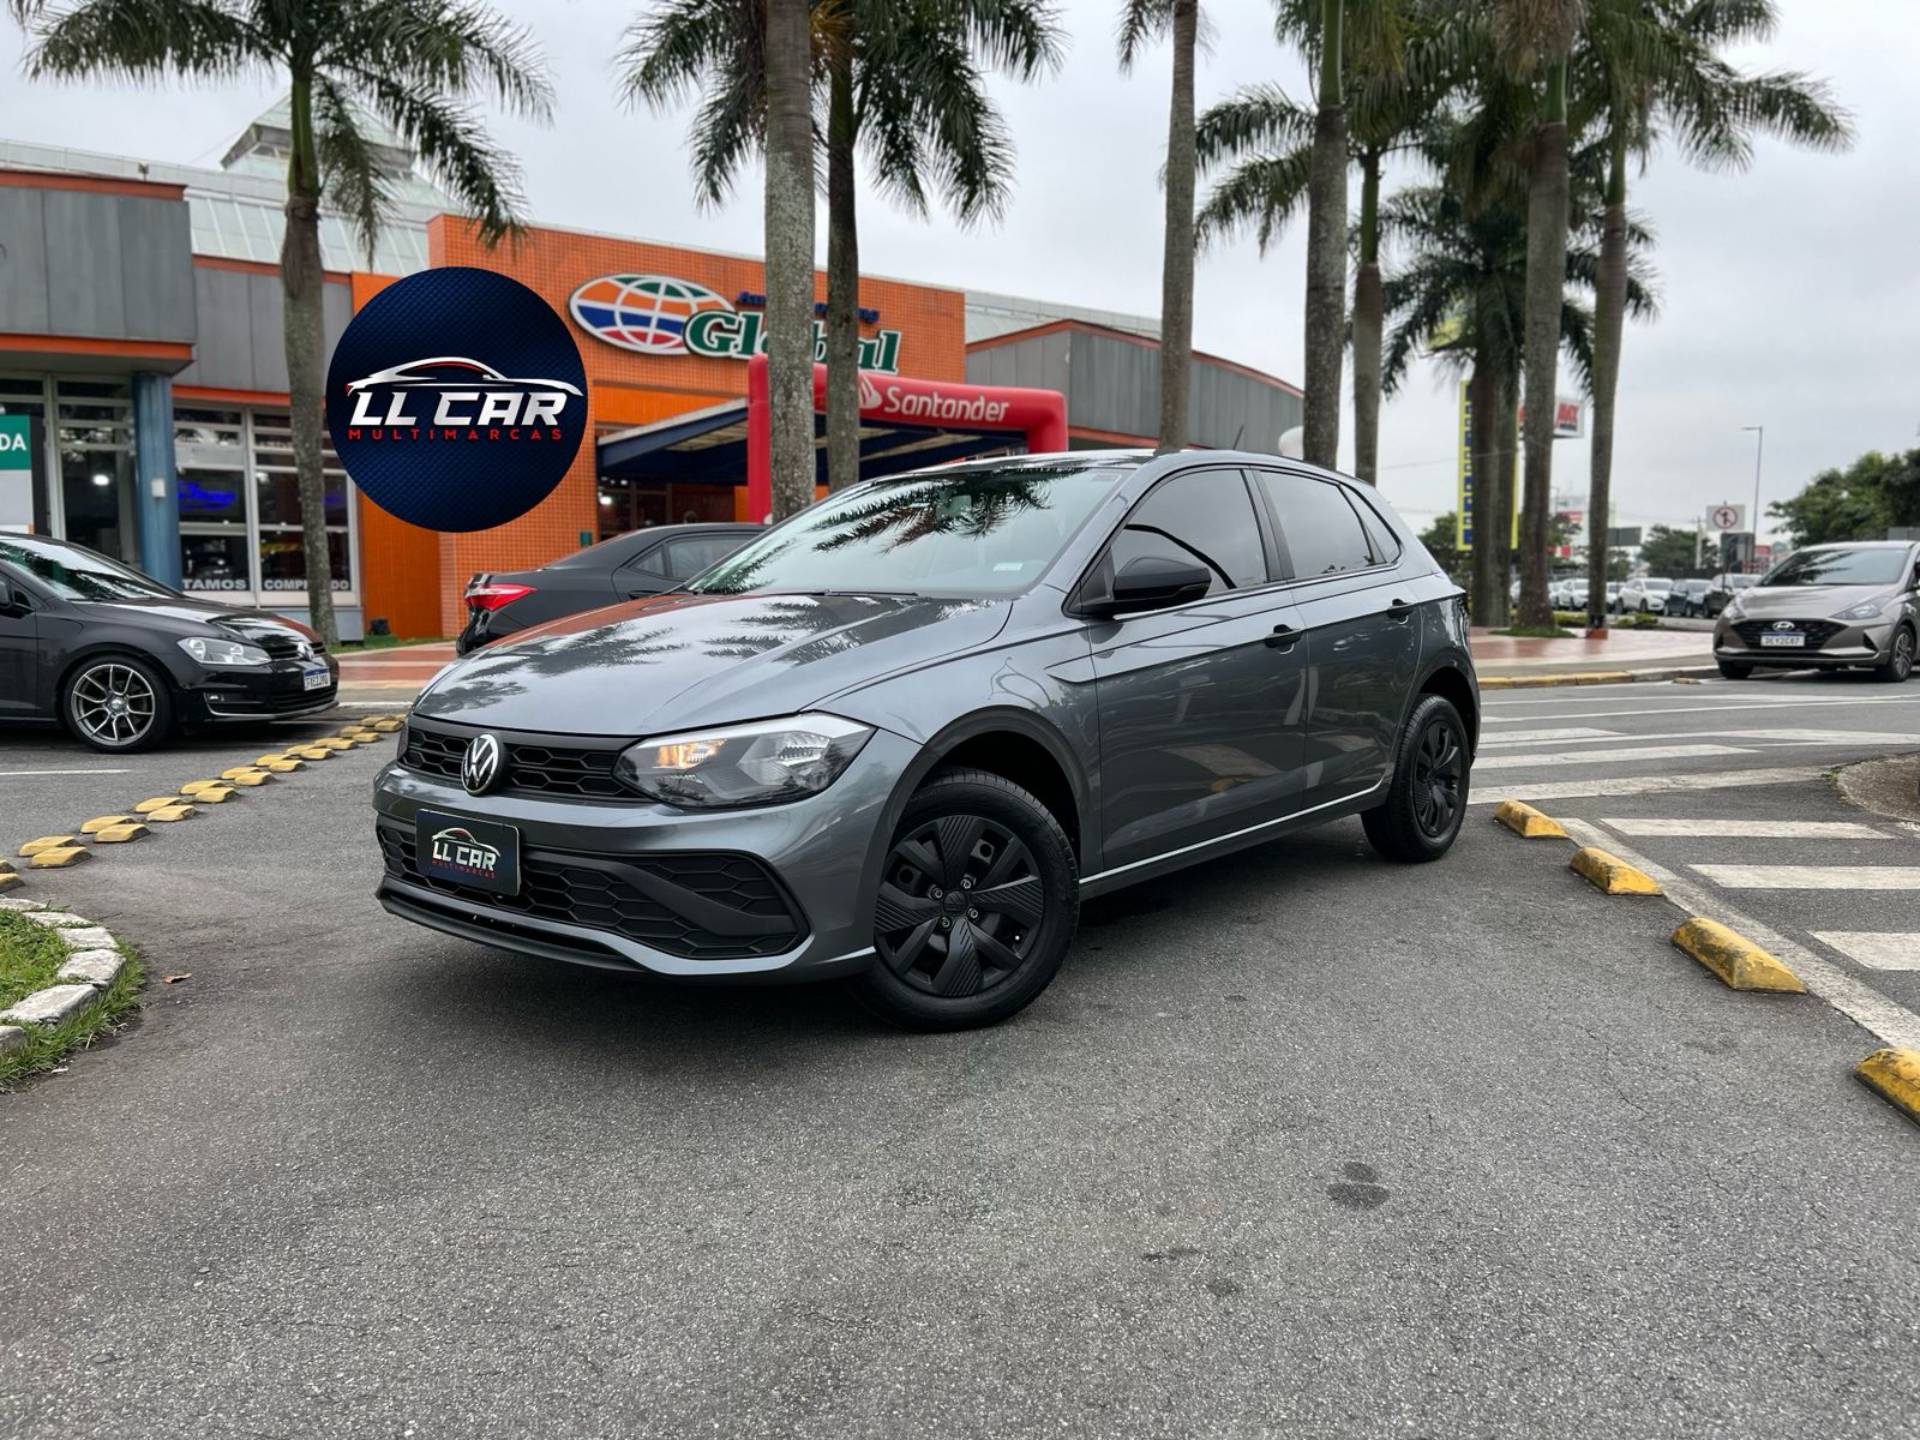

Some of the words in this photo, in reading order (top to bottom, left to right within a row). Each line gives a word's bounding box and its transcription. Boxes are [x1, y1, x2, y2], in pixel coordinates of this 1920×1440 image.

[884, 386, 1010, 422] Santander
[264, 579, 349, 590] COMPDO
[432, 841, 452, 862] LL
[456, 846, 497, 871] CAR
